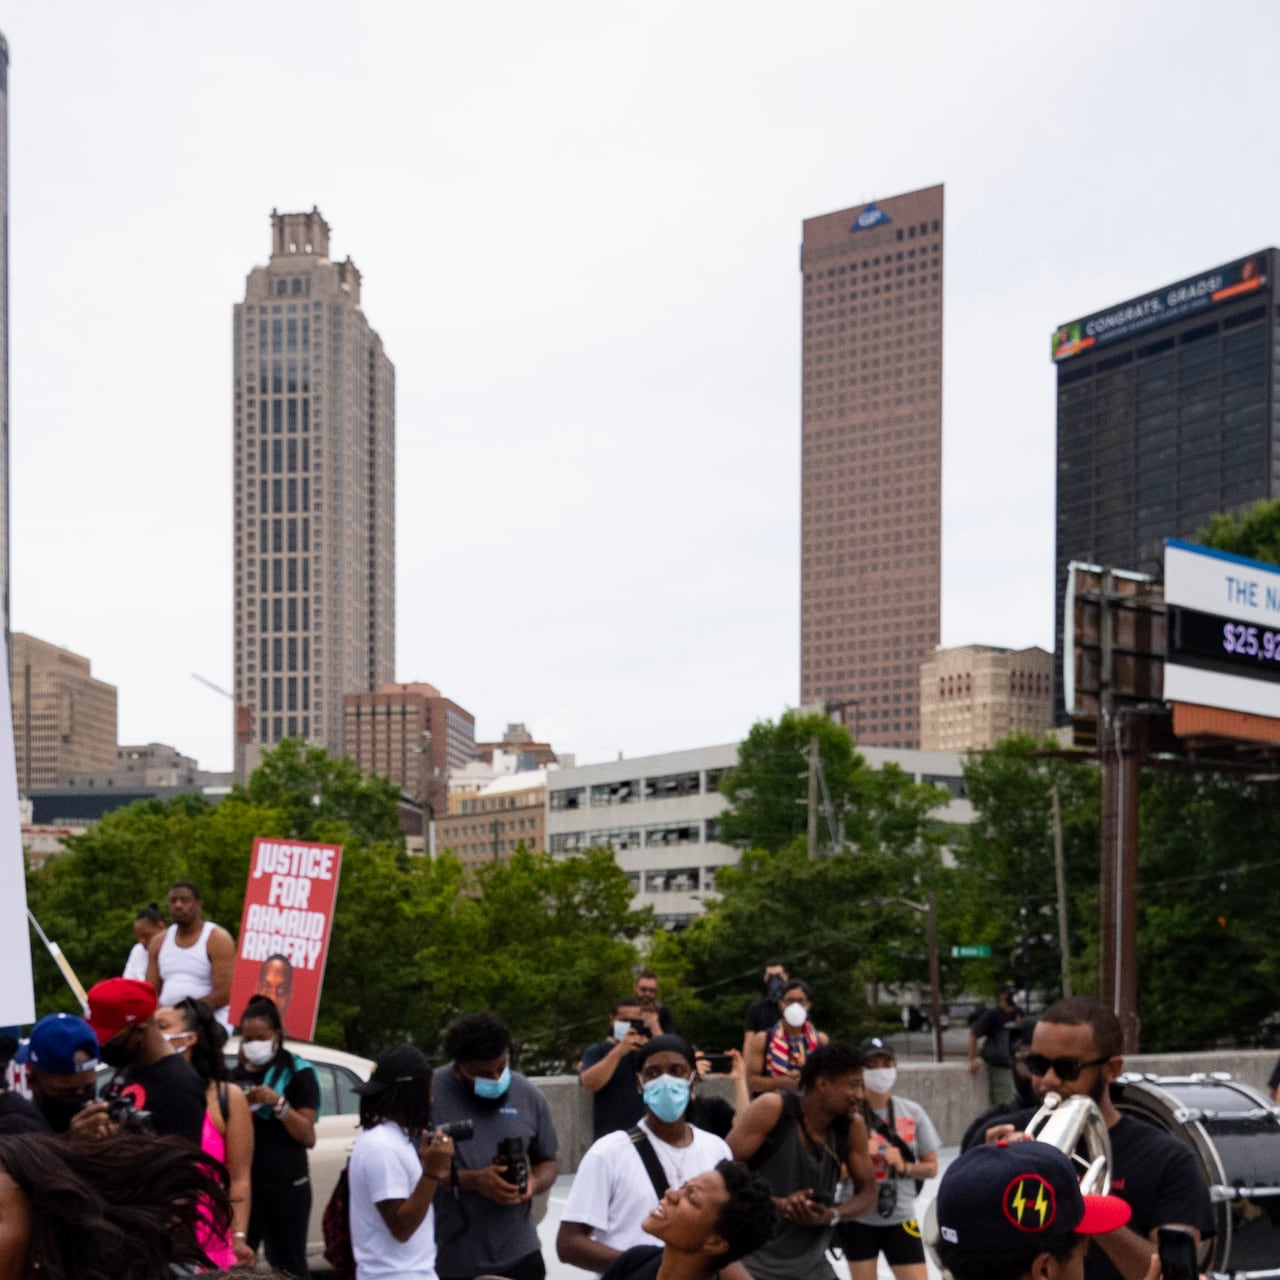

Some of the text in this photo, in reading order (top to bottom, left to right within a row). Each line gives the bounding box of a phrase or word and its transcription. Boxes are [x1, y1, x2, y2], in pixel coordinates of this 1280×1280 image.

[1085, 297, 1163, 336] CONGRATS,
[1167, 276, 1222, 306] GRADS!
[1225, 577, 1259, 608] THE
[253, 842, 335, 880] JUSTICE
[268, 873, 312, 909] FOR
[246, 904, 325, 940] AHMAUD
[241, 931, 322, 971] ARBERY
